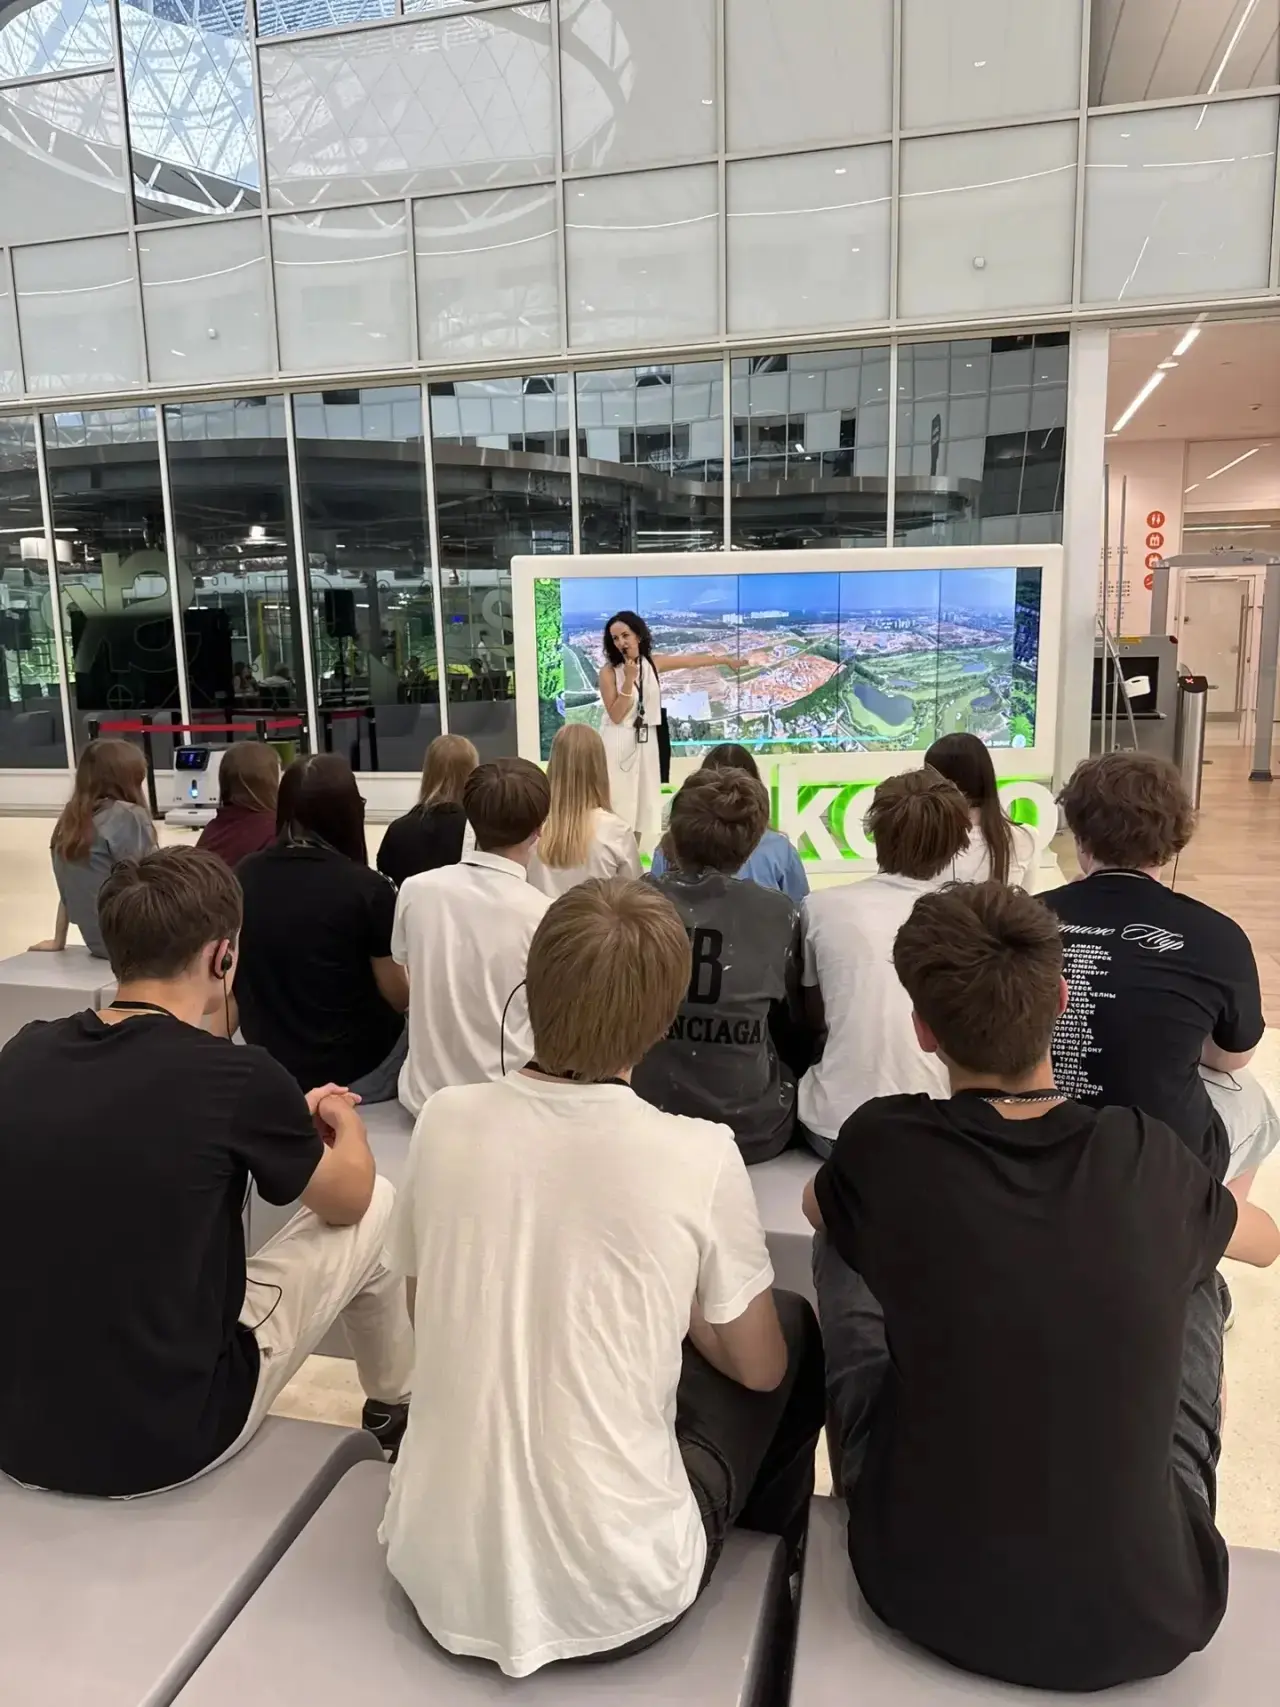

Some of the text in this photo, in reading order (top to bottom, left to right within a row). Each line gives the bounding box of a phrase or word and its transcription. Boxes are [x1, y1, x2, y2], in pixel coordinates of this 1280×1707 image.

[1061, 952, 1113, 961] ОВОСИБИРСК
[1062, 967, 1109, 976] АТЕРИНБУРГ
[662, 1015, 761, 1045] NCIAGA
[1054, 1025, 1092, 1034] ОЛГОГАД
[1053, 1068, 1088, 1076] ЛАДИМИР
